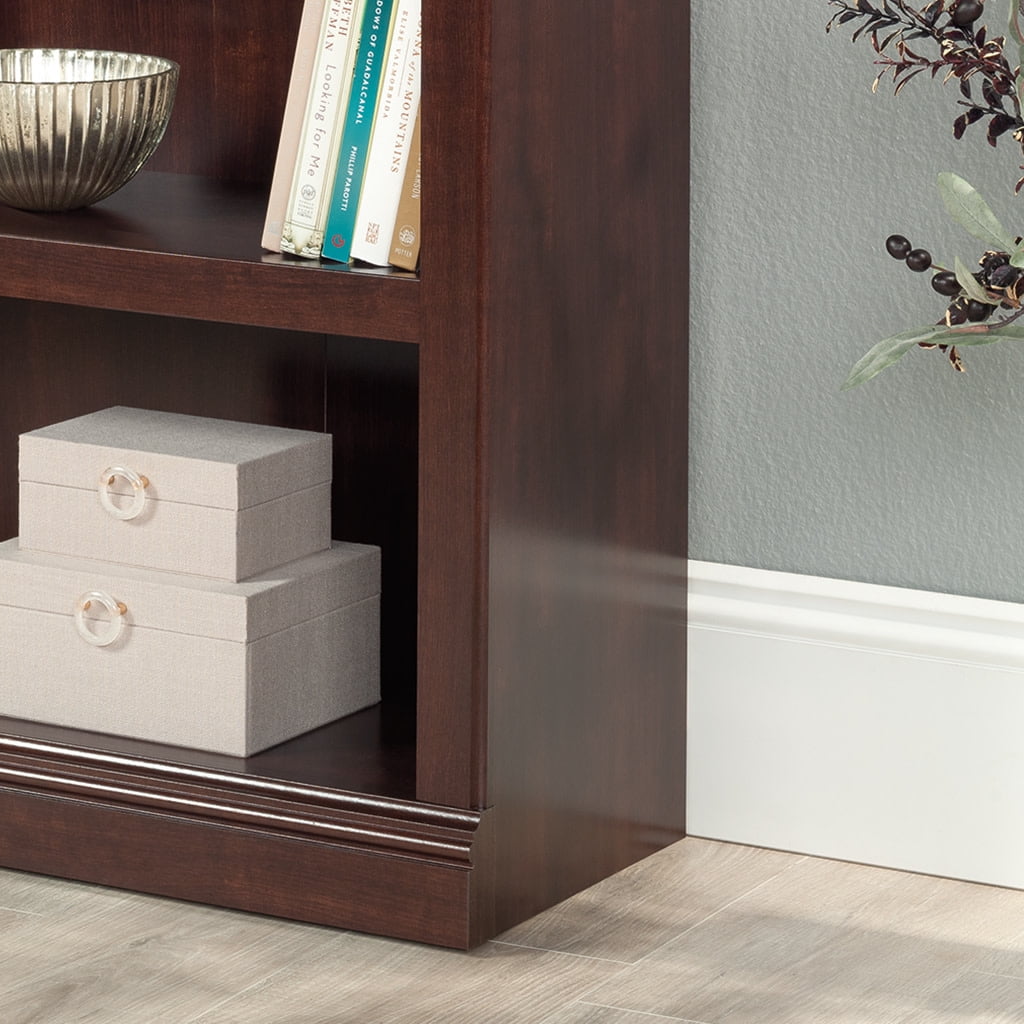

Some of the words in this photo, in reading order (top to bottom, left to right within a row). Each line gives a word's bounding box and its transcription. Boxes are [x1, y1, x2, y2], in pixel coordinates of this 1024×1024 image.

[370, 34, 378, 48] OF
[397, 10, 408, 42] ELISE
[409, 61, 417, 70] of
[314, 64, 337, 122] Looking
[355, 51, 374, 125] GUADALCANAL
[312, 128, 327, 148] for
[391, 89, 413, 174] MOUNTAINS
[306, 155, 321, 178] Me
[346, 146, 358, 175] PHILLIP
[340, 177, 353, 212] PAROTTI
